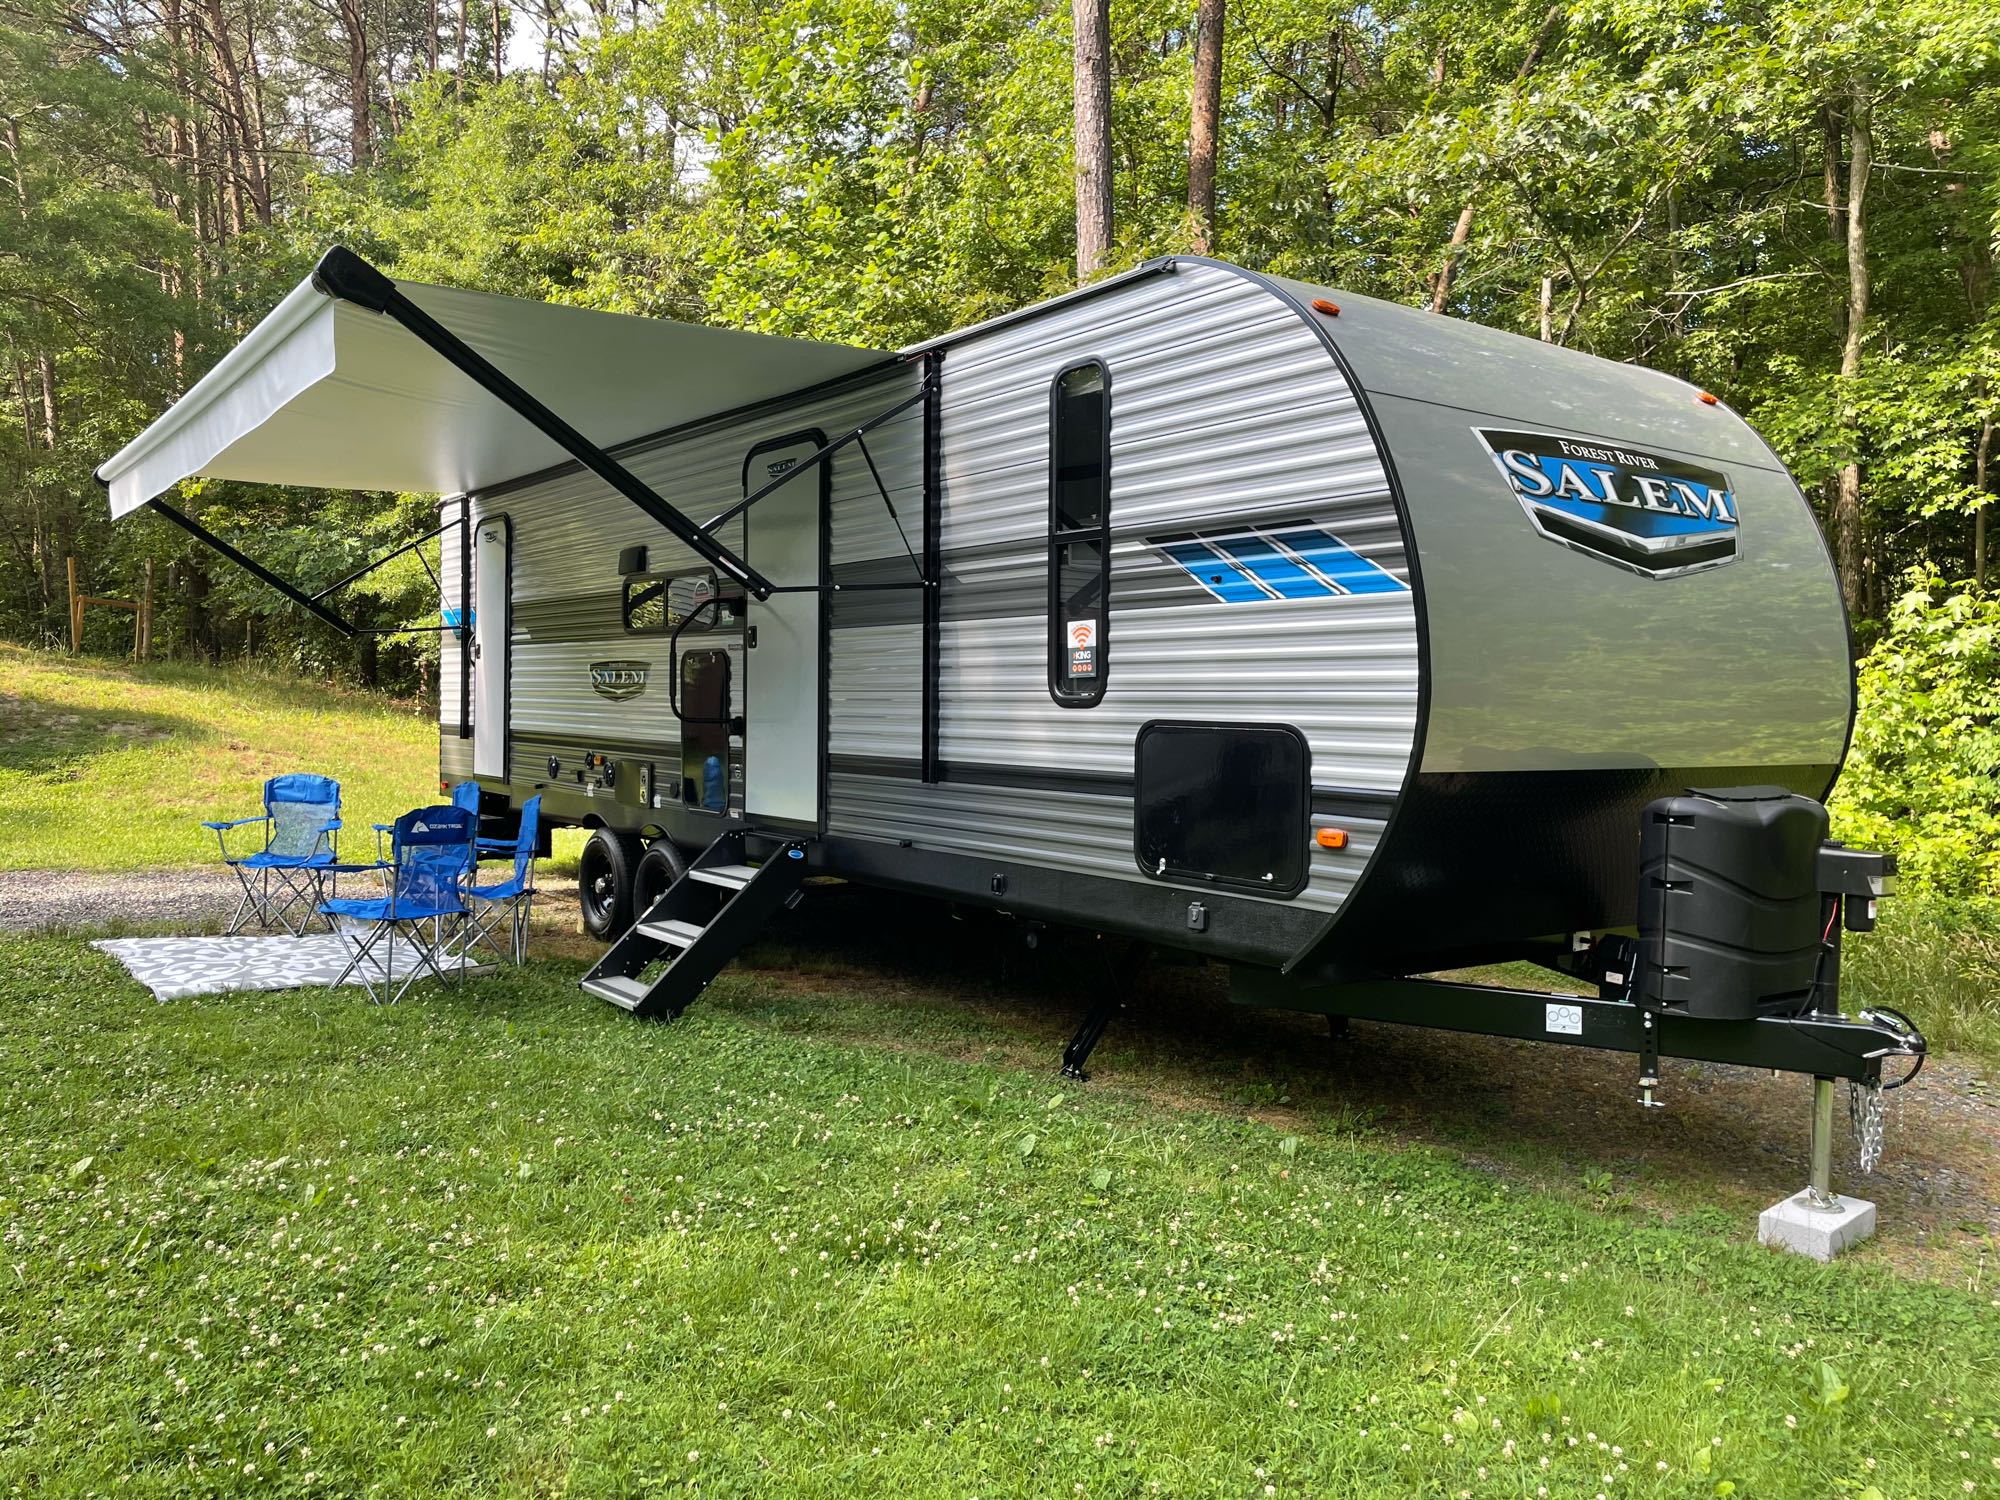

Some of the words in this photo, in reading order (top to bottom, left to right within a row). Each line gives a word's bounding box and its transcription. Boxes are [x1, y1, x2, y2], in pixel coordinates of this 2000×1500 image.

[1558, 440, 1614, 463] FOREST
[1615, 450, 1660, 470] RIVER
[1502, 449, 1736, 524] SALEM
[1075, 650, 1092, 660] KING
[592, 668, 645, 684] SALEM
